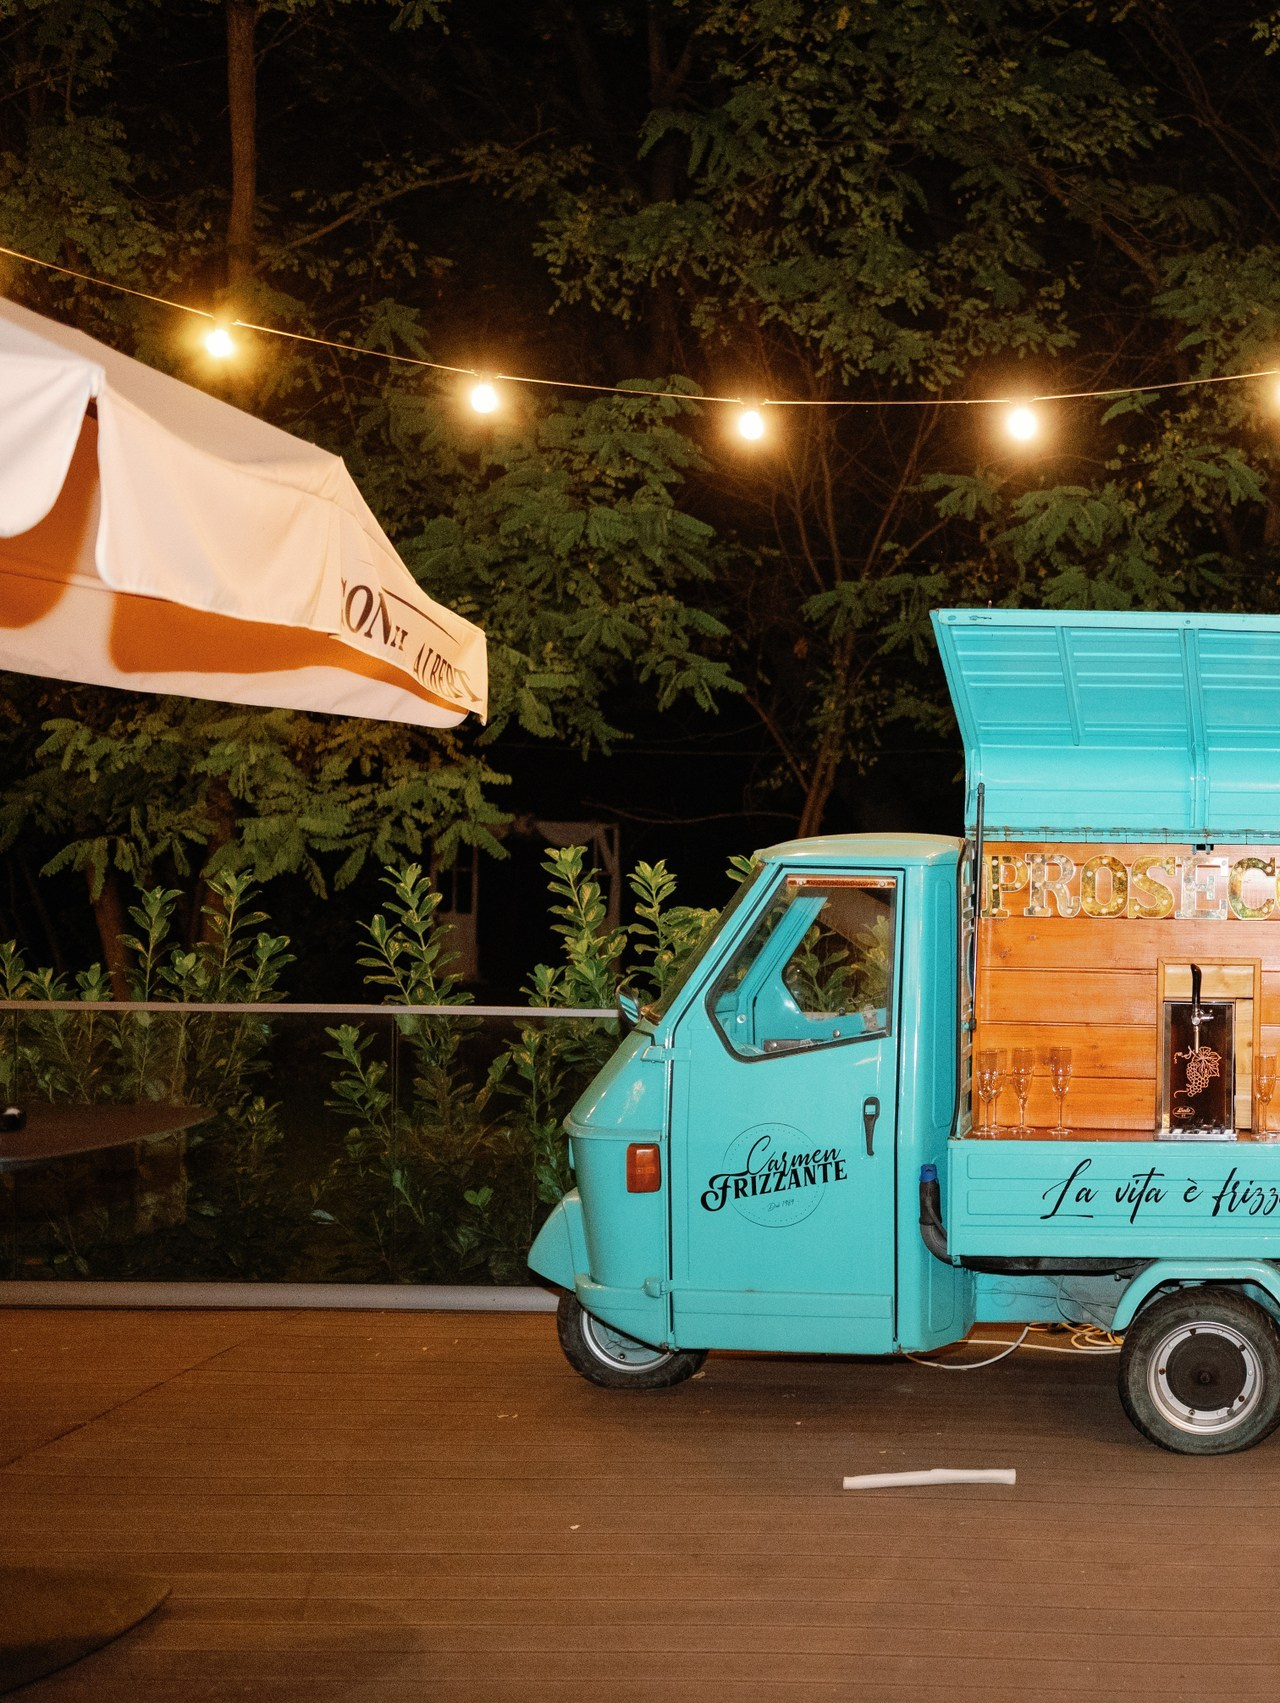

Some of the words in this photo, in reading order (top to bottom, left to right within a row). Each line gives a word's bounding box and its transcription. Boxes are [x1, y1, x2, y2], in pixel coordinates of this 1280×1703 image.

[747, 1135, 841, 1177] Carmen
[701, 1159, 848, 1212] FRIZZANTE
[1040, 1158, 1098, 1219] La
[1115, 1167, 1168, 1224] vita
[1183, 1178, 1203, 1203] è
